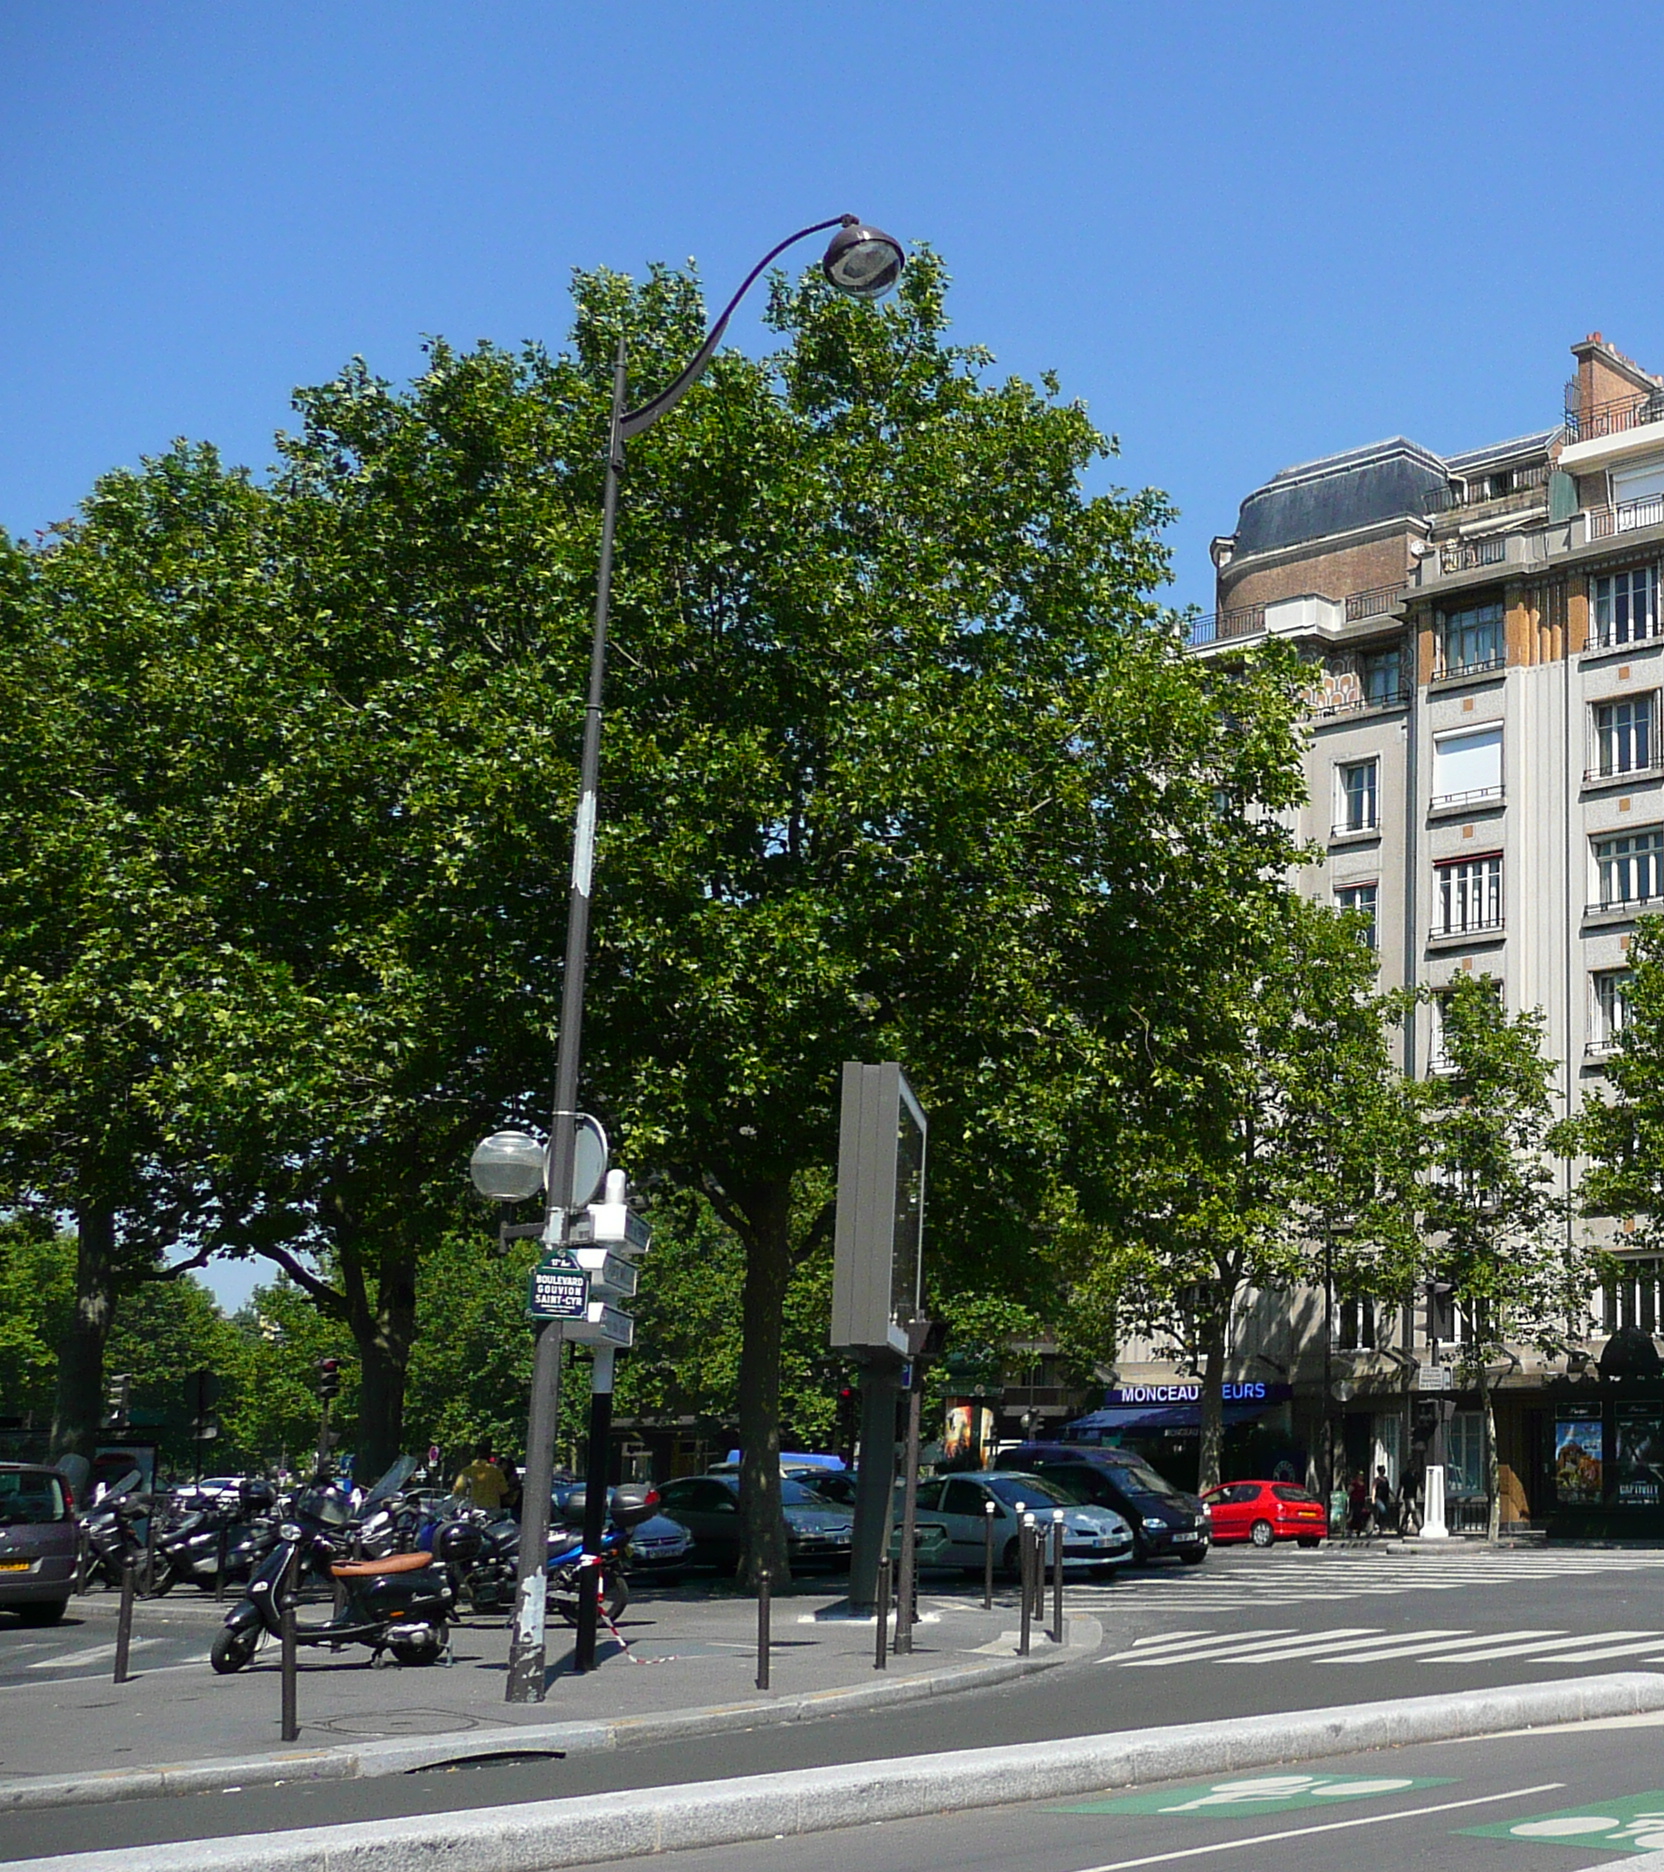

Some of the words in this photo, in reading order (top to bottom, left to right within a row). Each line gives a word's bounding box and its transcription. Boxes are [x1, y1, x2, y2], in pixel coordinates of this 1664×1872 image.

[536, 1275, 584, 1286] BOULEVARD
[537, 1285, 582, 1295] GOUVION
[535, 1294, 583, 1306] SAINT-CYR
[1121, 1385, 1199, 1402] MONCEAU
[1221, 1383, 1265, 1399] EURS
